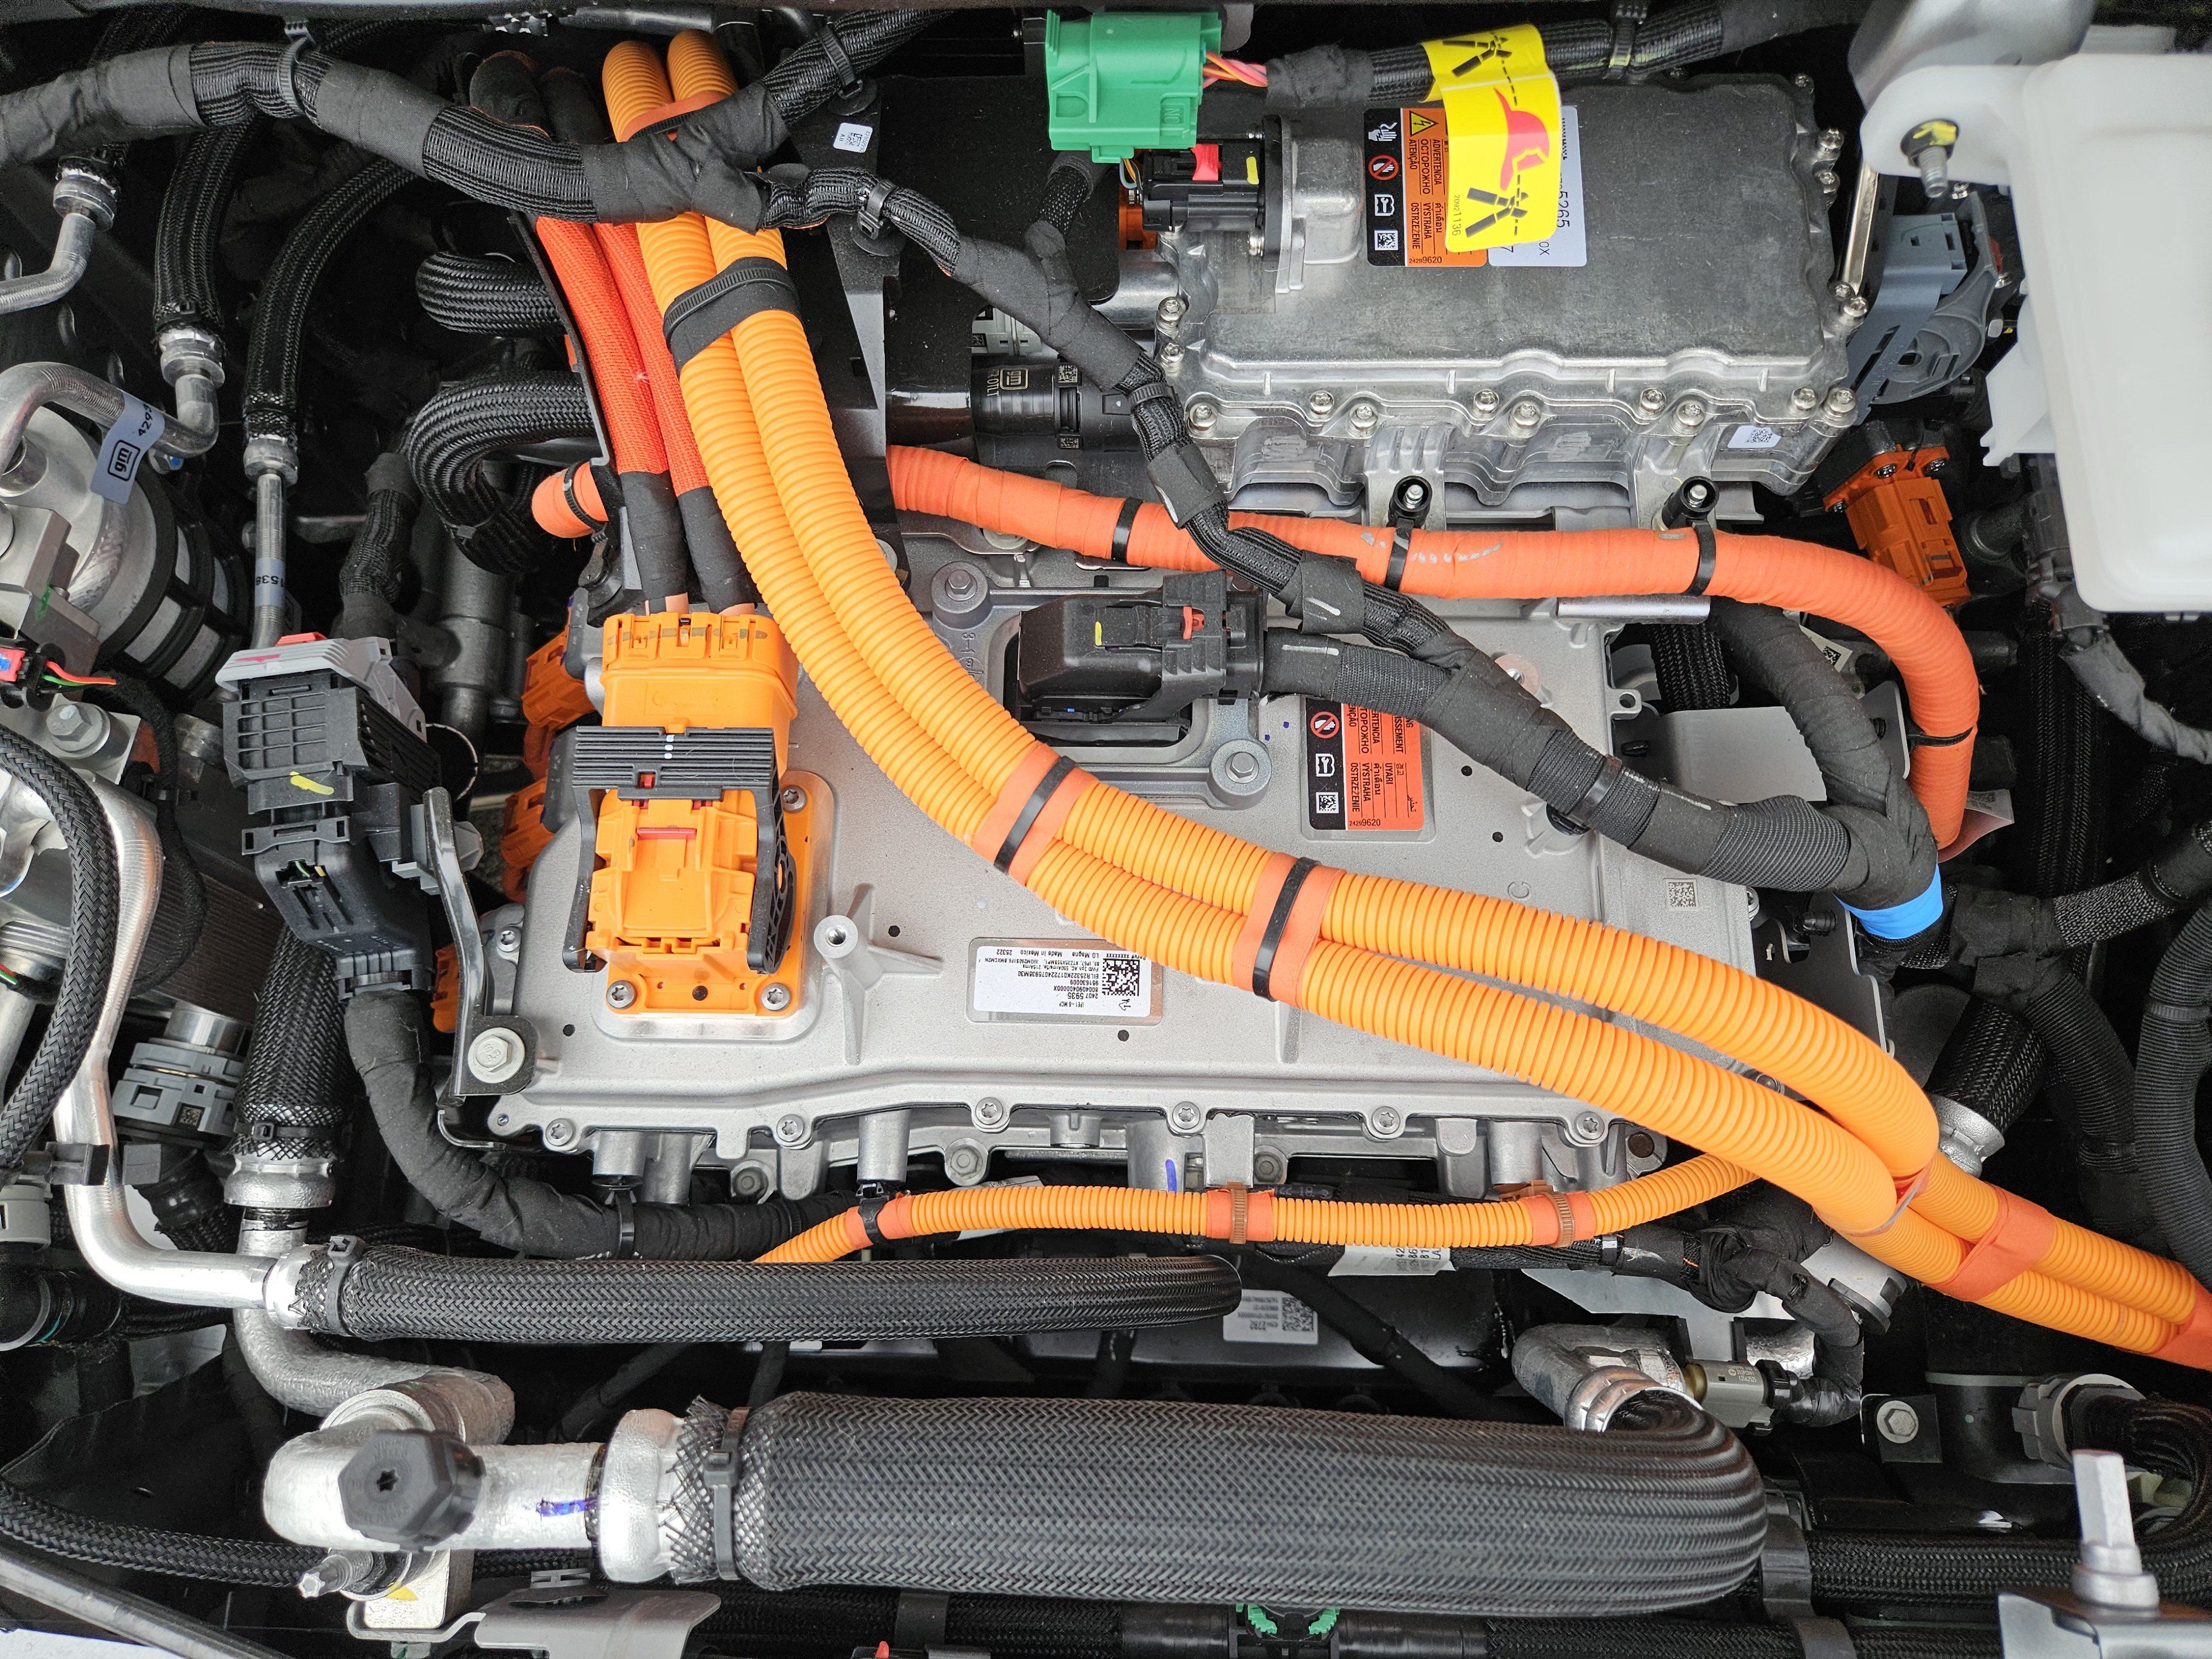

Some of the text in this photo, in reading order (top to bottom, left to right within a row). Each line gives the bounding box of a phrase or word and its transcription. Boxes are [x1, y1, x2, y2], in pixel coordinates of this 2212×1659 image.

[1407, 139, 1418, 169] ATENÇÃO
[1433, 139, 1443, 185] ADVERTENCIA
[1423, 203, 1433, 239] VÝSTRAHA
[1452, 195, 1462, 236] 20921136
[1007, 371, 1021, 385] gm
[114, 448, 132, 472] gm
[1363, 763, 1372, 801] VÝSTRAHA
